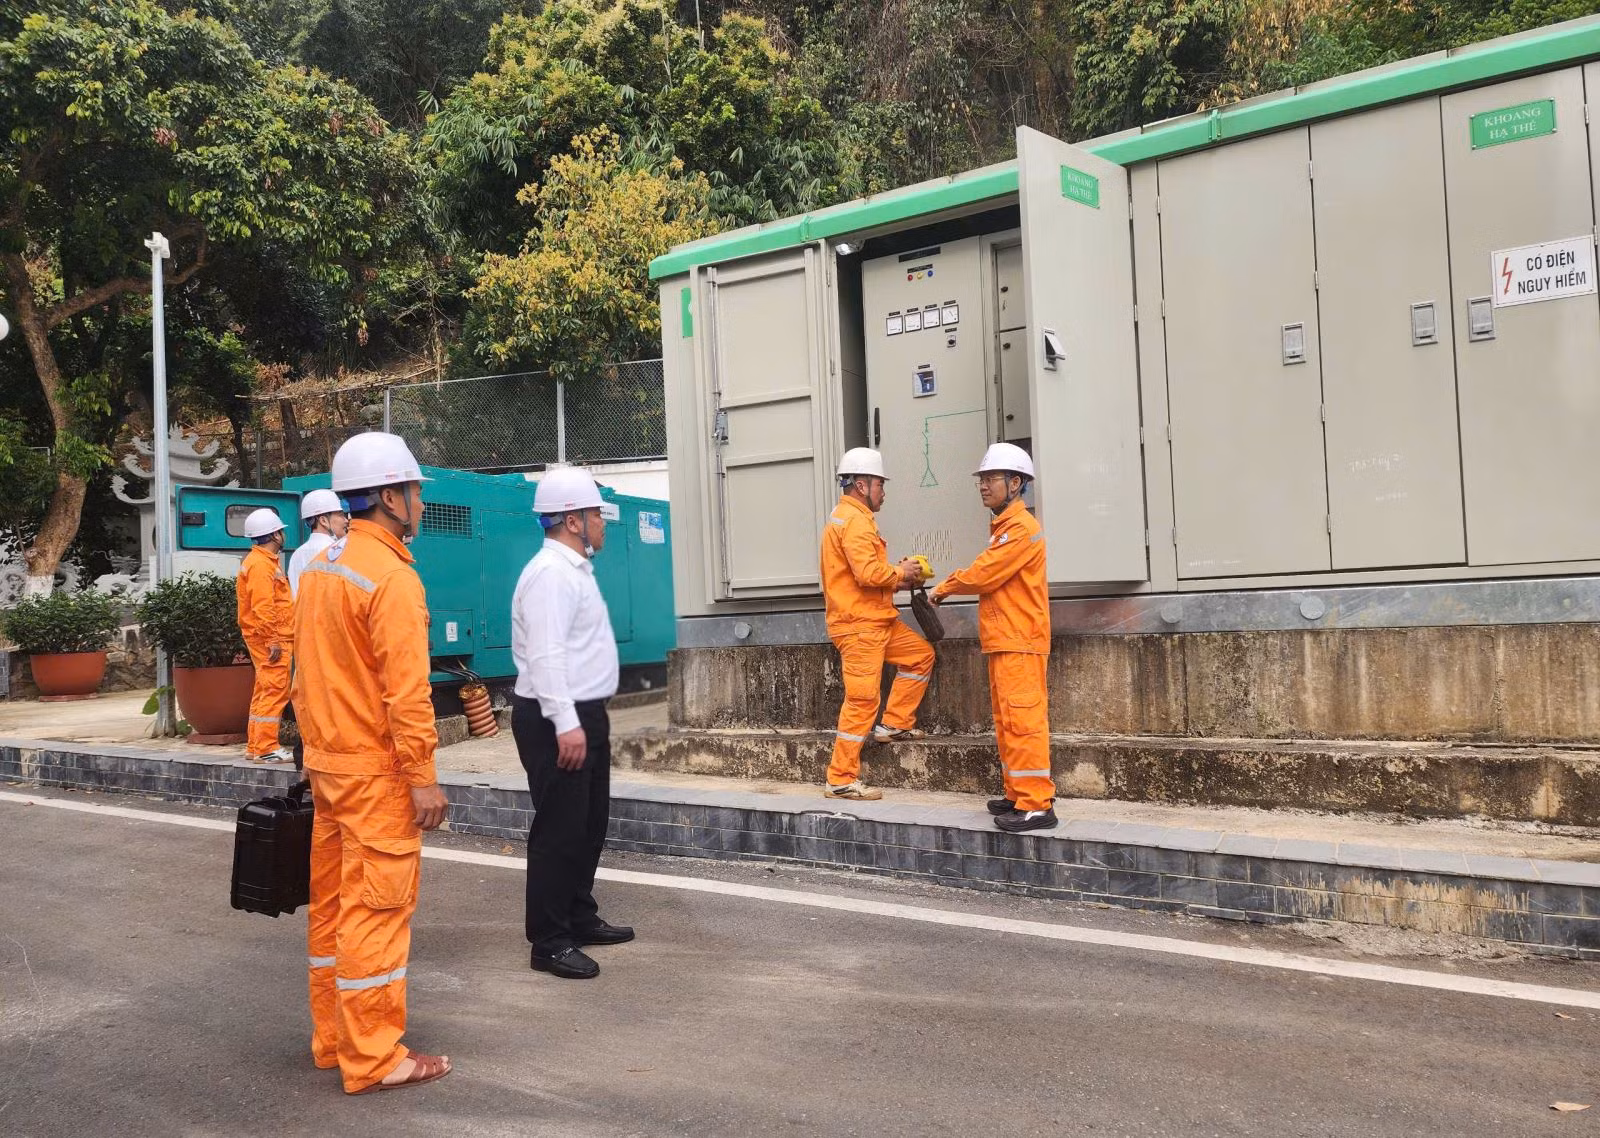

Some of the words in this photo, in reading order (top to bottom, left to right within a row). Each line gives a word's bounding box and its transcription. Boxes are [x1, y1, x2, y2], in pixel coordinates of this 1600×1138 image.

[1484, 107, 1541, 127] KHOANG
[1489, 128, 1508, 139] HẠ
[1526, 252, 1542, 271] CÓ
[1546, 249, 1575, 268] ĐIỆN
[1518, 276, 1552, 295] NGUY
[1555, 267, 1586, 288] HIỂM
